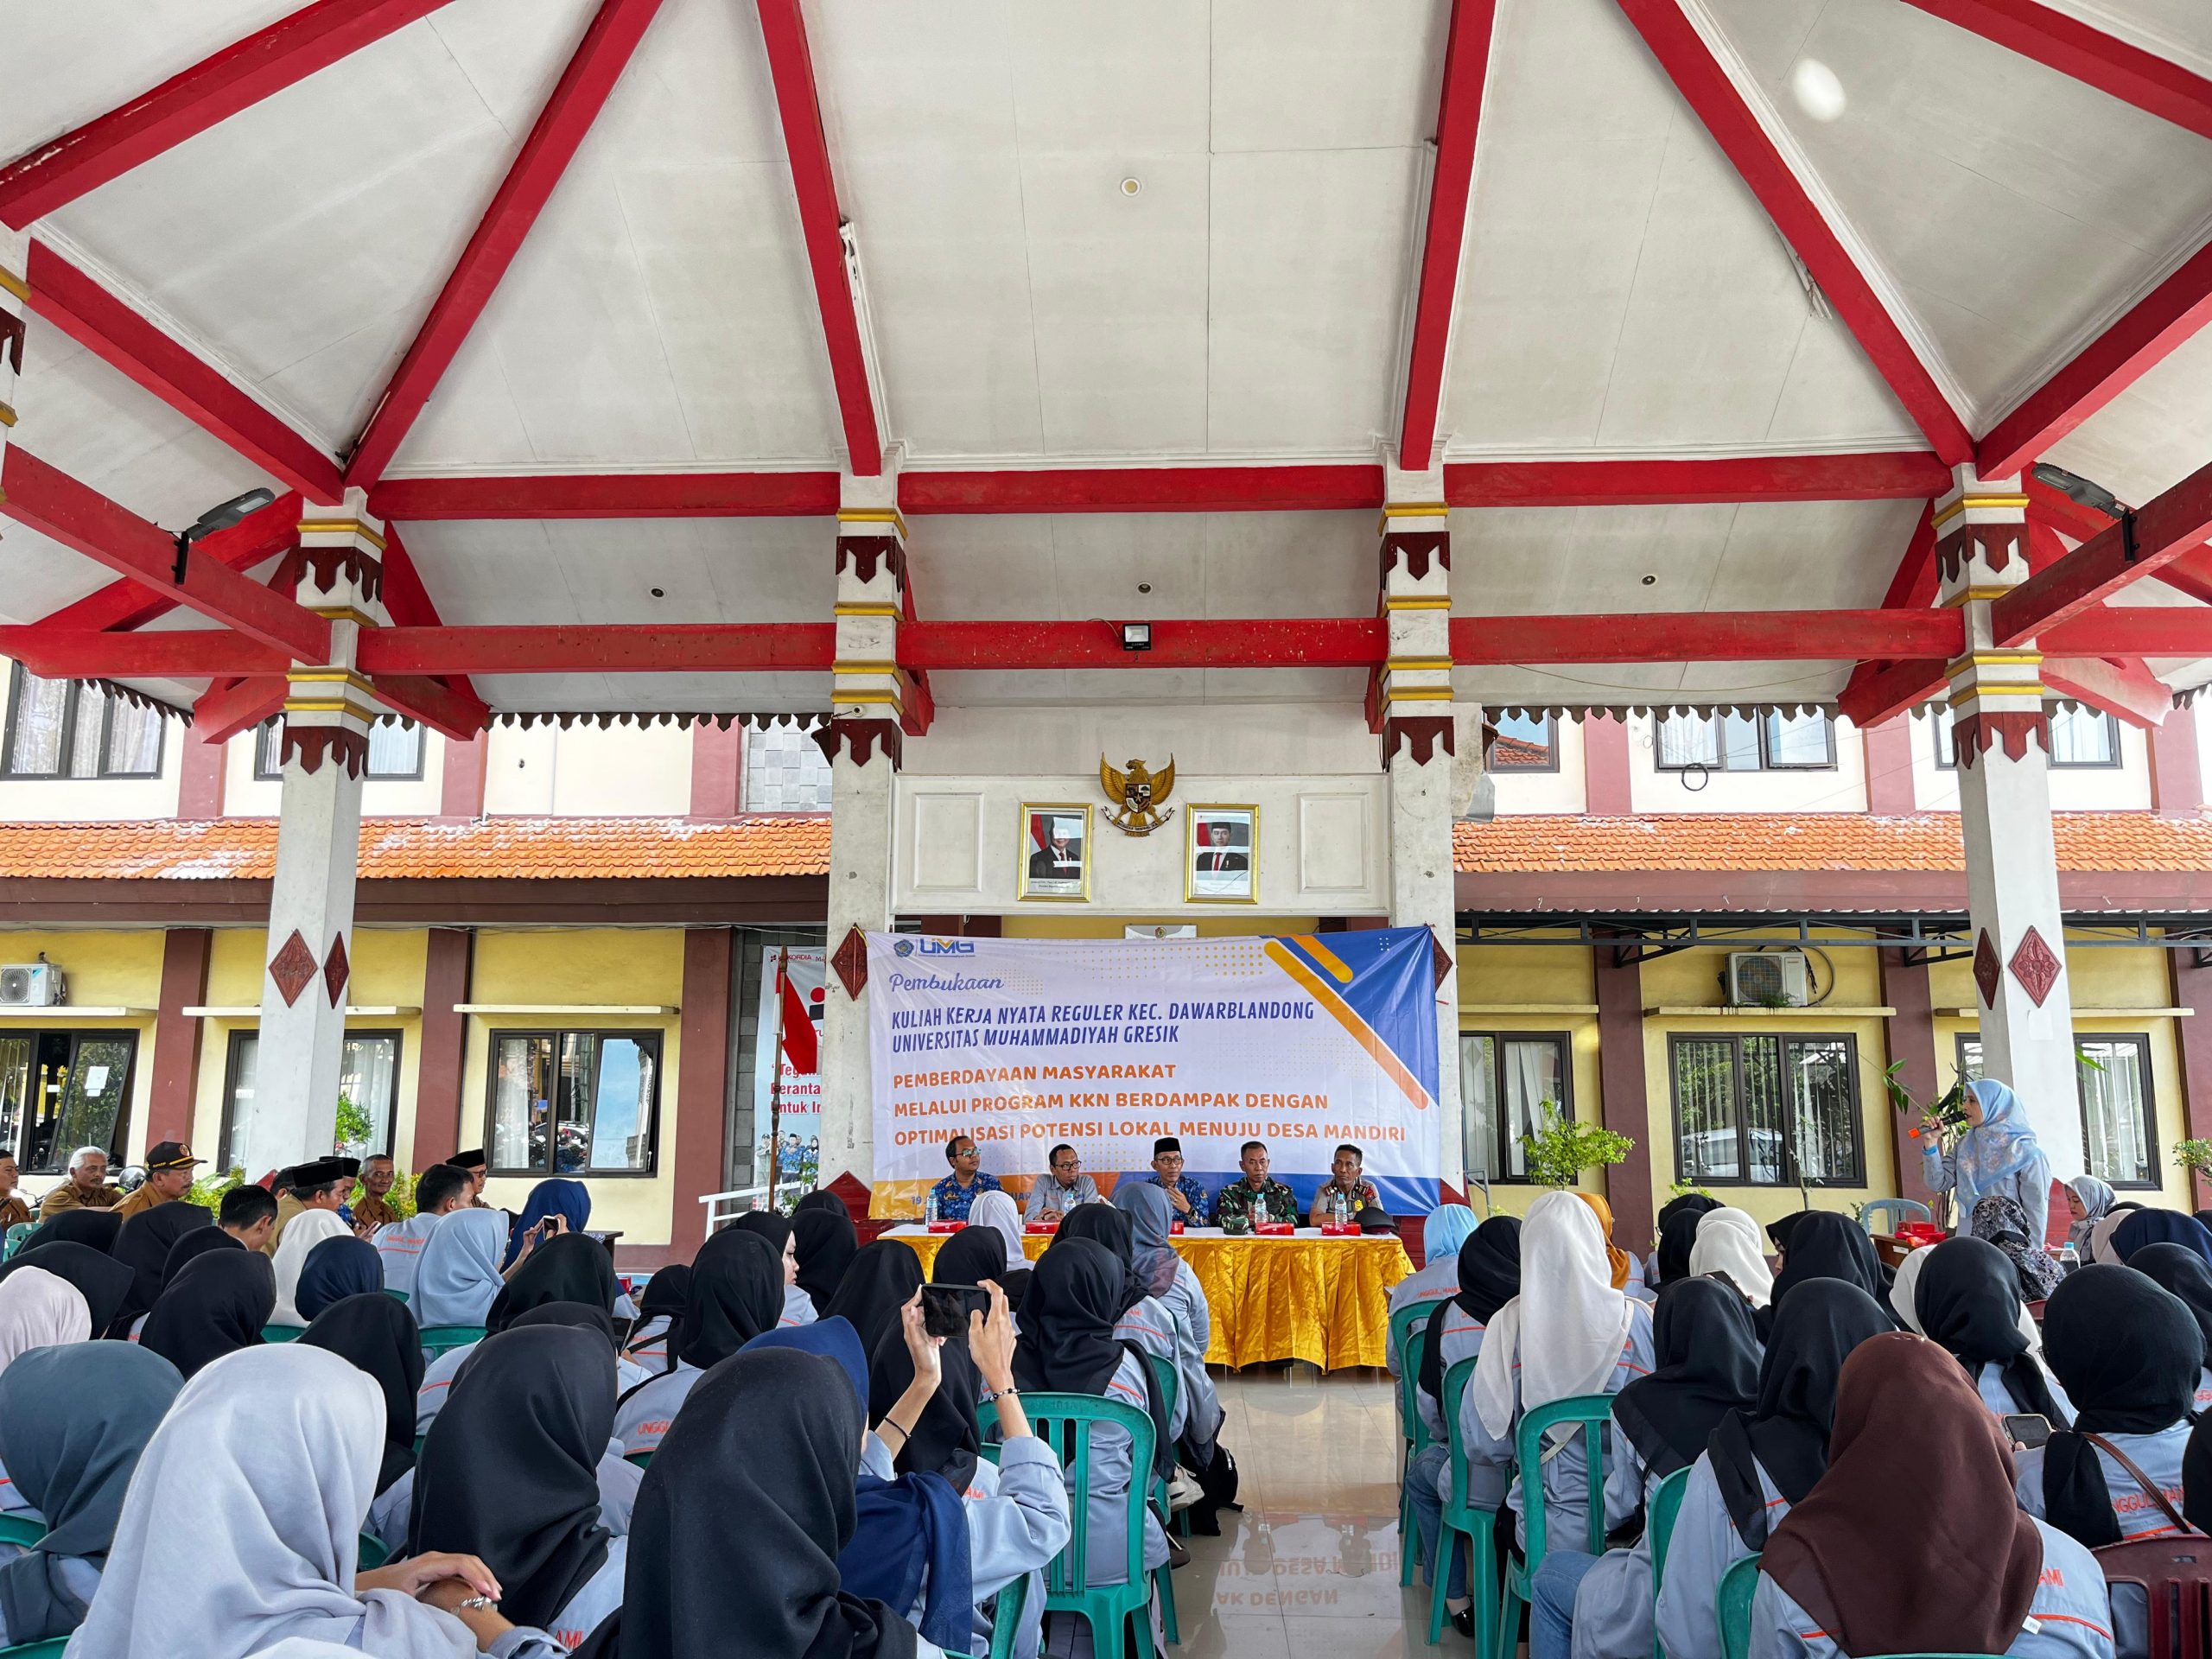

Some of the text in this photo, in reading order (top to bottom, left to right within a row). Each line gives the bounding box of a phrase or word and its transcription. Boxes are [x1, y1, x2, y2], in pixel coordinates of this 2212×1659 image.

[919, 938, 975, 954] UMG
[889, 972, 1004, 992] Pembukaan
[892, 1001, 1314, 1029] KULIAH KERJA NYATA REGULER KEC. DAWARBLANDONG
[893, 1025, 1179, 1052] UNIVERSITAS MUHAMMADIYAH GRESIK
[893, 1064, 1176, 1089] PEMBERDAYAAN MASYARAKAT
[894, 1092, 1328, 1117] MELALUI PROGRAM KKN BERDAMPAK DENGAN
[1020, 1122, 1103, 1139] POTENSI
[1109, 1122, 1173, 1136] LOKAL
[1179, 1122, 1262, 1137] MENUJU
[1267, 1122, 1319, 1139] DESA
[1324, 1124, 1406, 1141] MANDIRI
